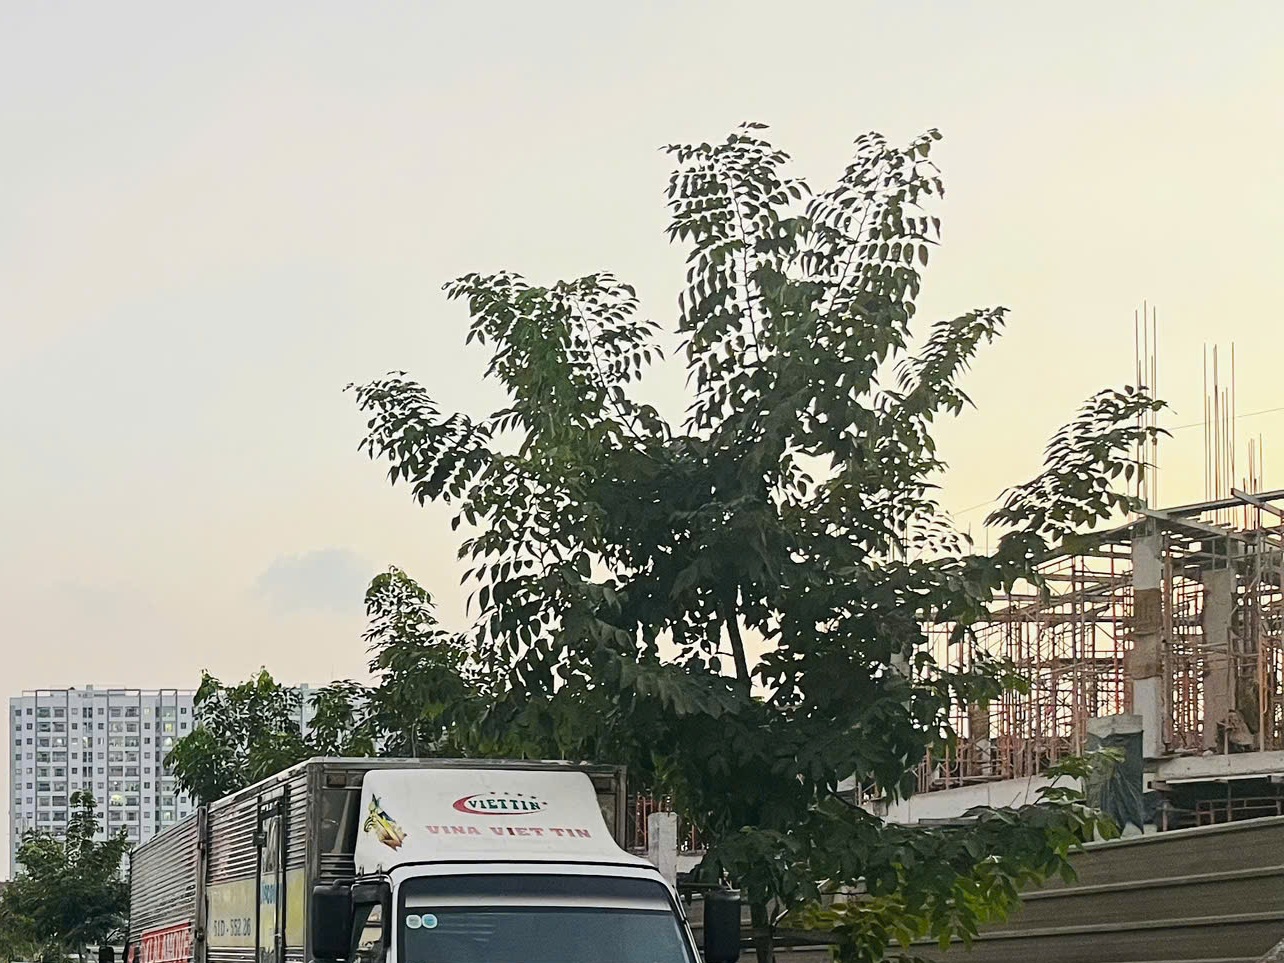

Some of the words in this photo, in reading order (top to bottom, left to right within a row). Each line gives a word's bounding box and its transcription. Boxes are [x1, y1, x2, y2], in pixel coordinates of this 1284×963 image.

[426, 825, 482, 836] VINA
[489, 826, 545, 837] VIET
[549, 827, 592, 838] TIN
